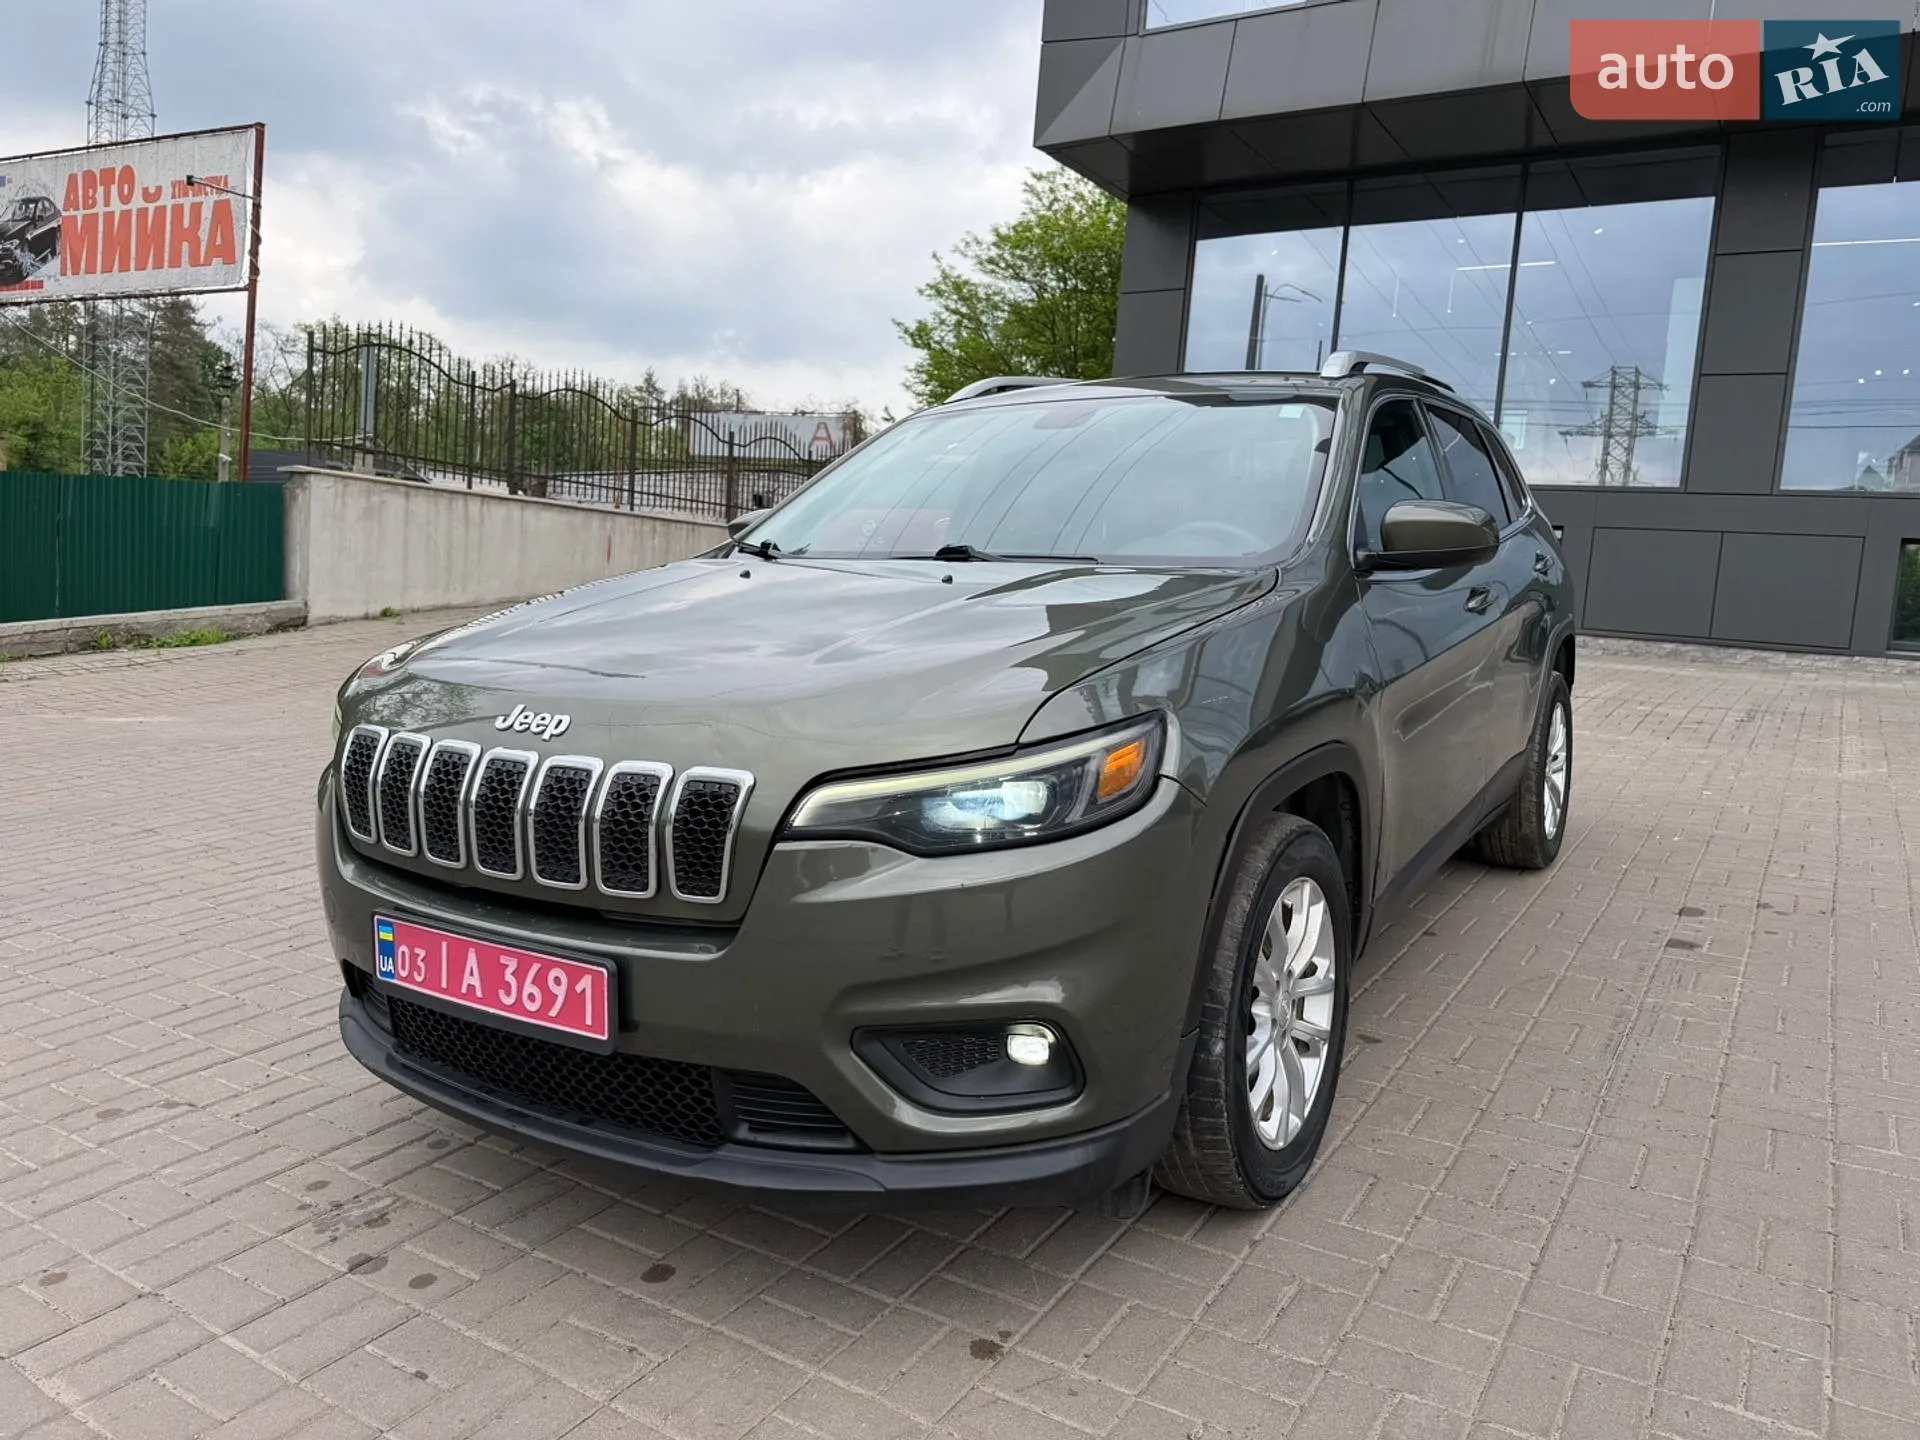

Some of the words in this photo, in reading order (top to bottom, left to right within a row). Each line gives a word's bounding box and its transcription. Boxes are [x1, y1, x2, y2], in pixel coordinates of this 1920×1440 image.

[62, 164, 136, 212] АВТО
[494, 703, 572, 741] Jeep
[379, 955, 395, 974] UA
[397, 944, 427, 983] 03
[498, 954, 593, 1026] 3691
